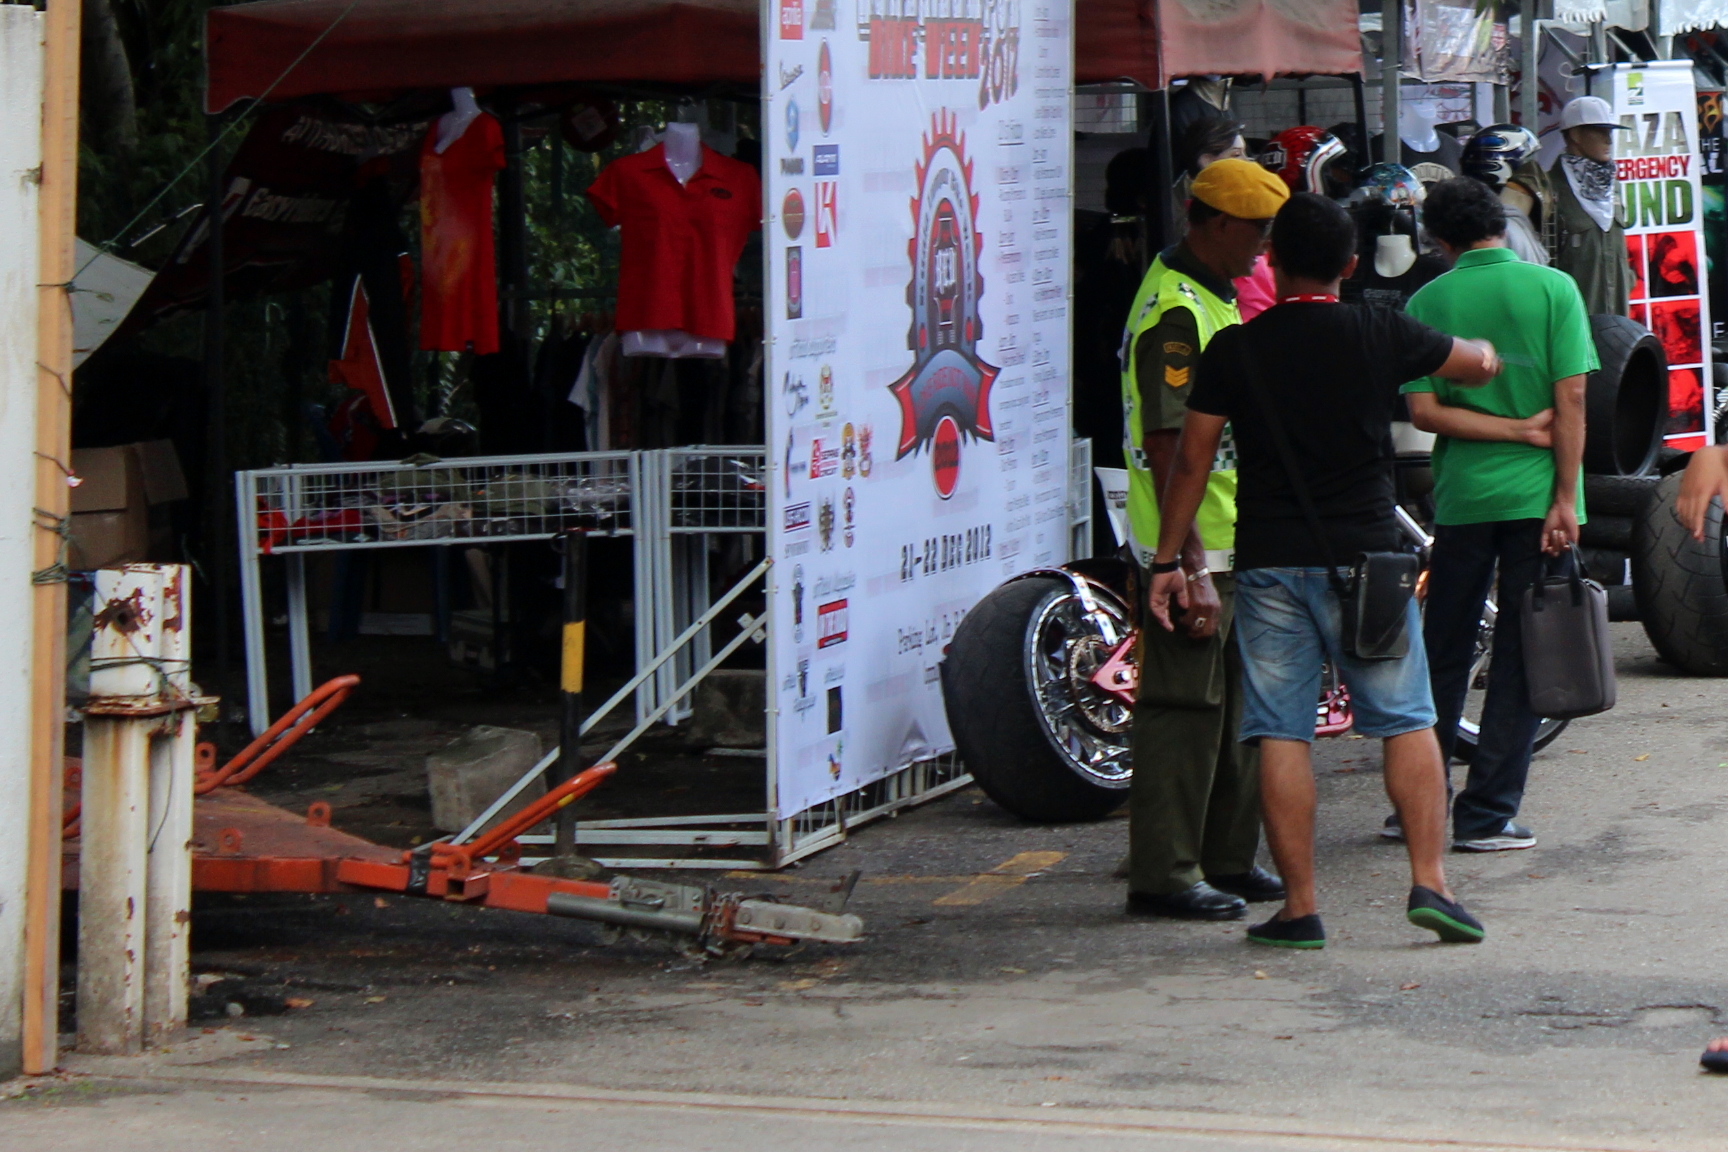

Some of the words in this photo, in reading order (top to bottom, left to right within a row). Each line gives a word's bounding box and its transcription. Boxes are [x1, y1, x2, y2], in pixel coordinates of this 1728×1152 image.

[924, 17, 983, 80] WEEK
[1616, 111, 1690, 158] AZA
[1615, 155, 1691, 181] ERGENCY
[1620, 179, 1693, 230] UND
